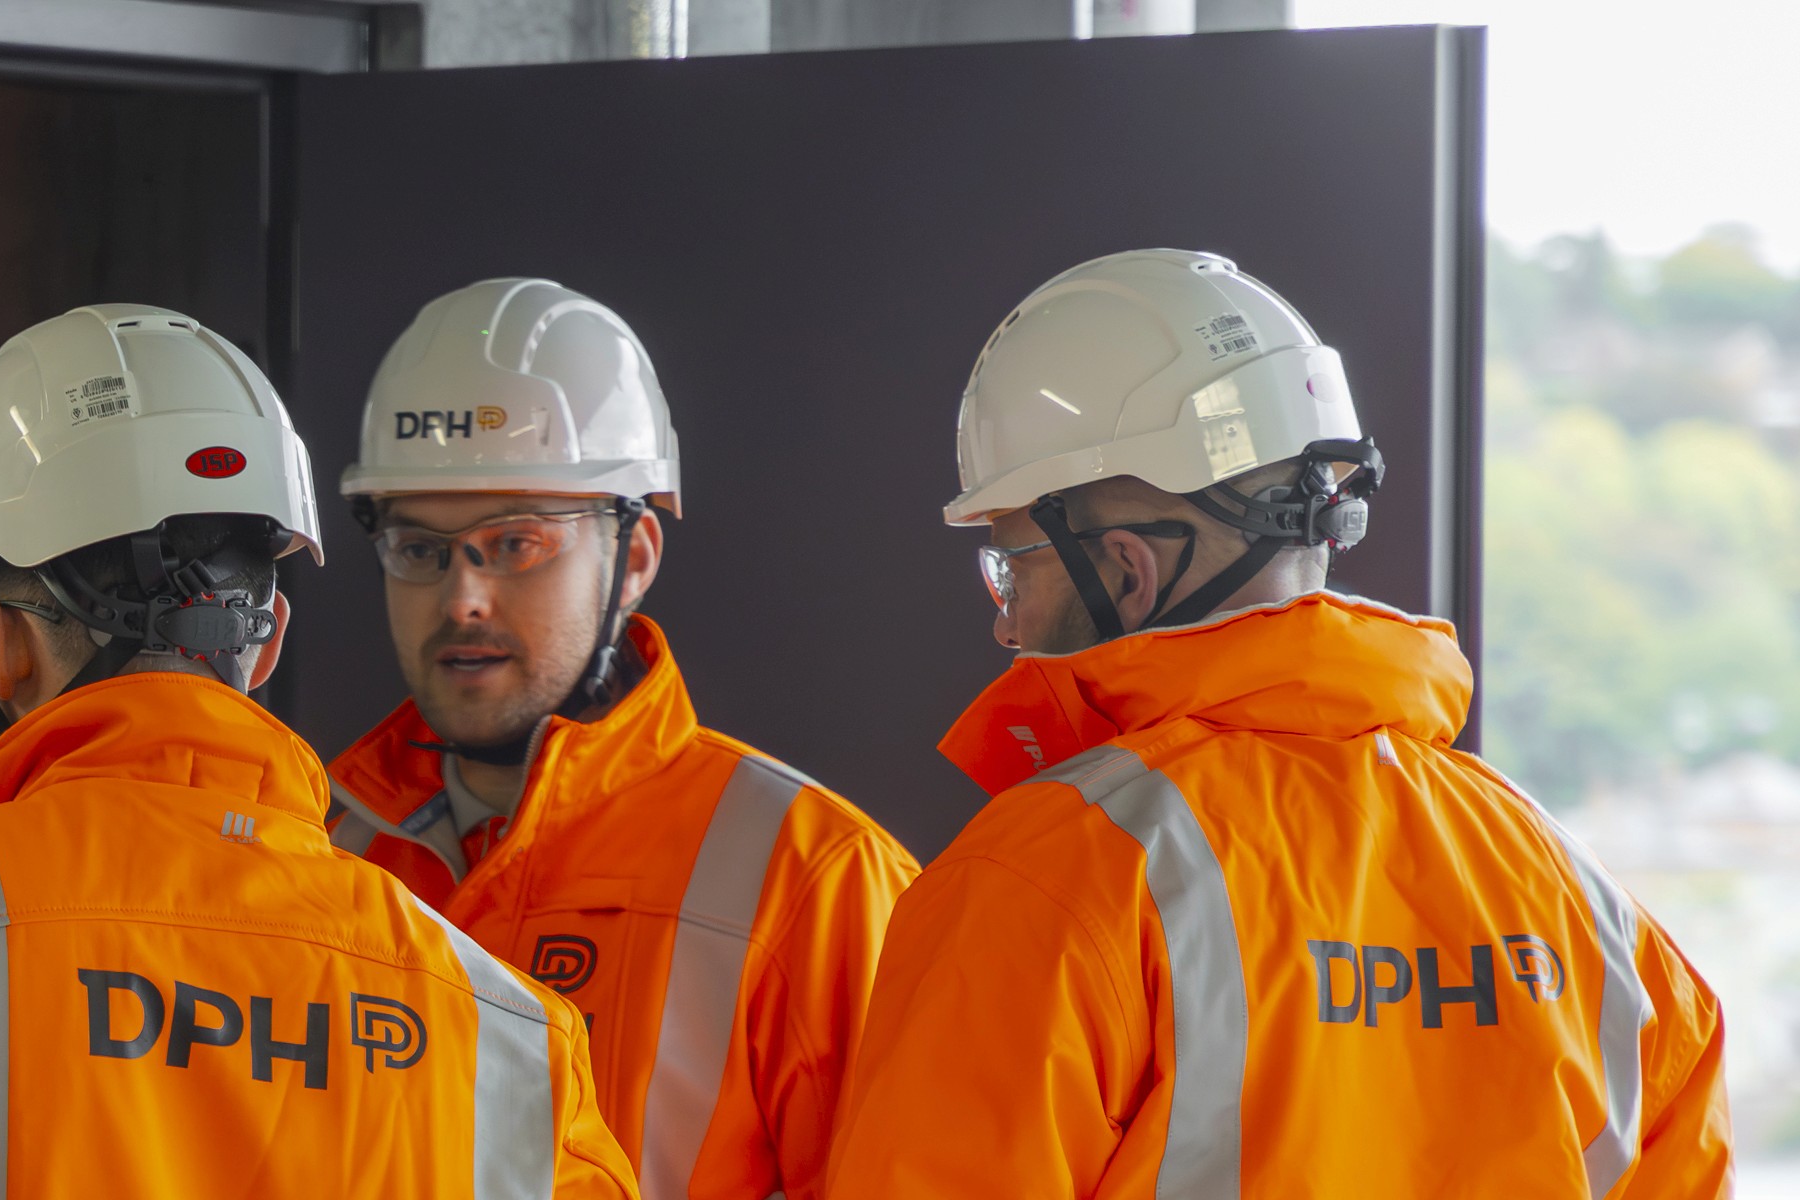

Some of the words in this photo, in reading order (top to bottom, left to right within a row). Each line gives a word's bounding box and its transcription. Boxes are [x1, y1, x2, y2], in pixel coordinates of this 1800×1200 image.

[395, 411, 473, 439] DPH
[197, 452, 238, 472] JSP
[1306, 939, 1499, 1029] DPH
[77, 967, 330, 1091] DPH
